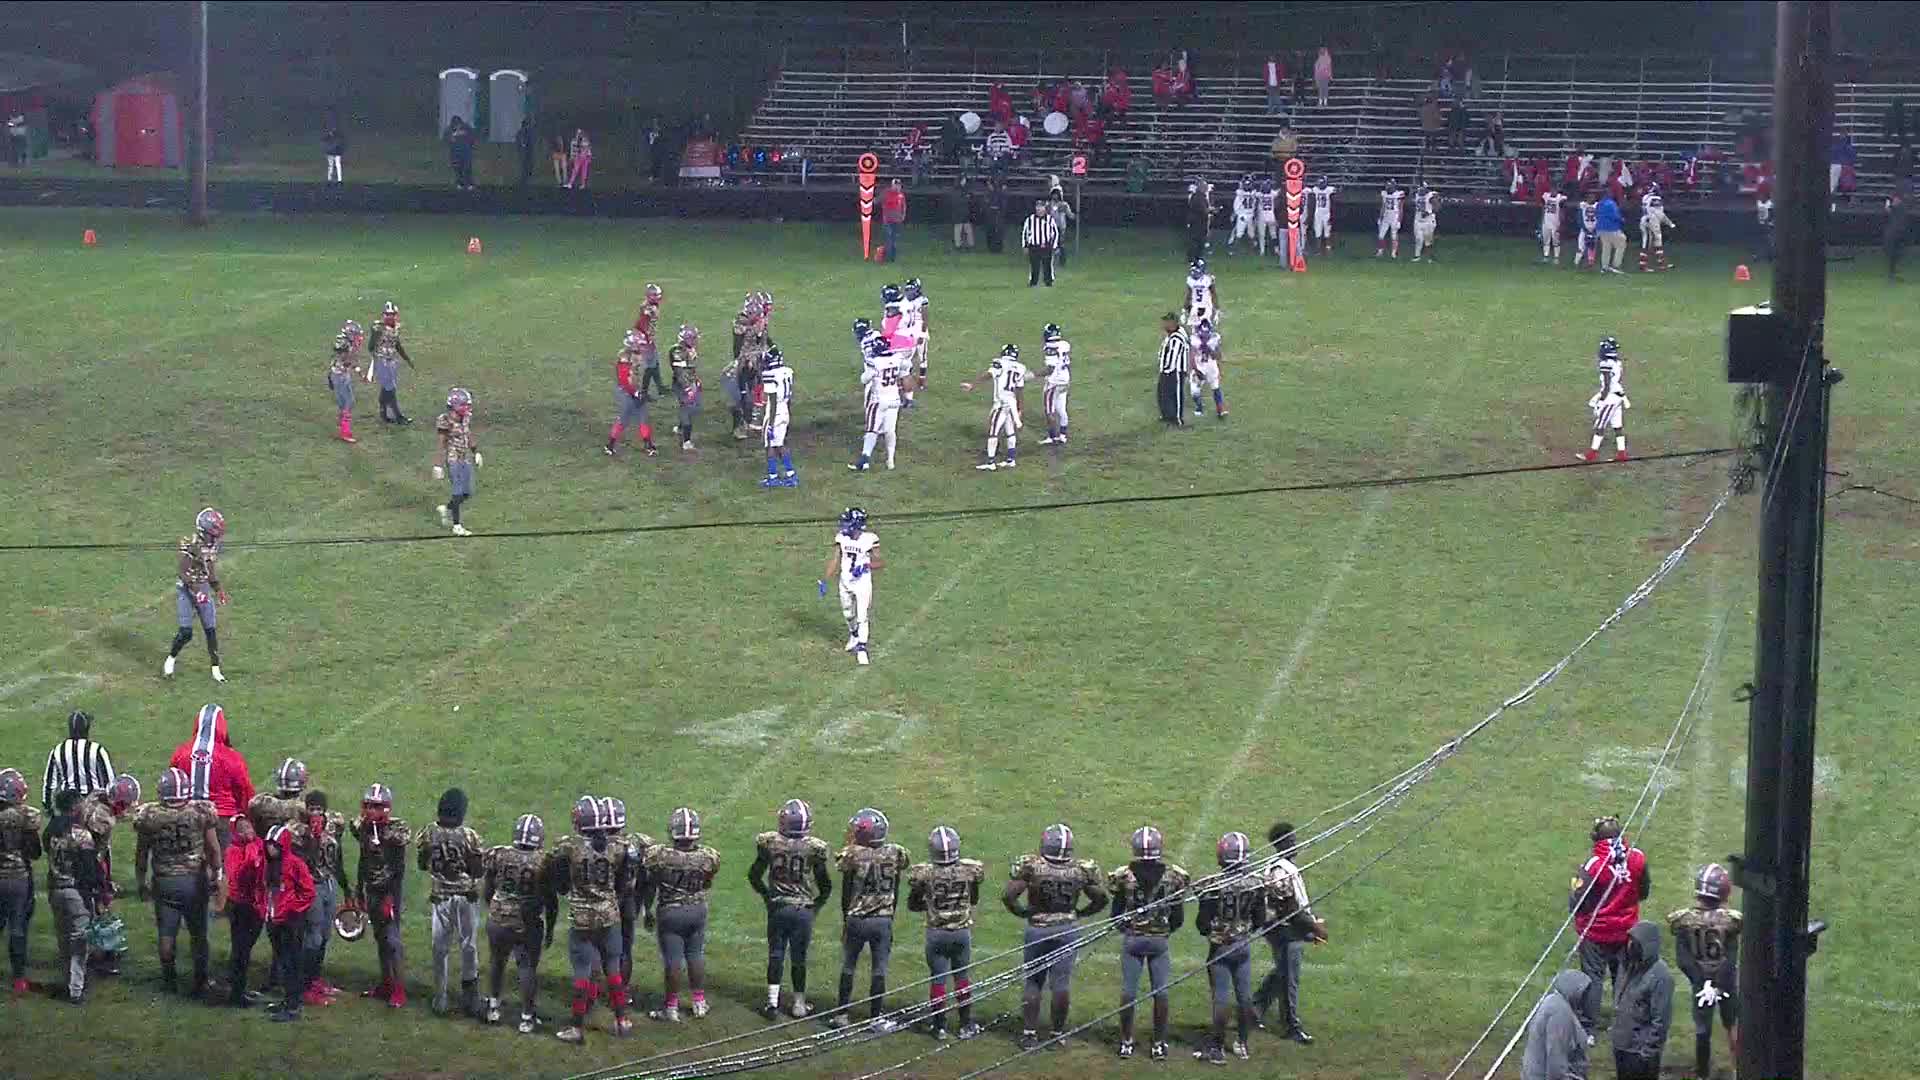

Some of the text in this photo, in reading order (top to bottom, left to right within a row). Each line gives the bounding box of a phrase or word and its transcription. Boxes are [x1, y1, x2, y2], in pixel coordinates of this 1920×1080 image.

[1072, 157, 1086, 174] 2
[1196, 288, 1203, 302] 5
[882, 367, 898, 386] 55
[847, 552, 857, 574] 7
